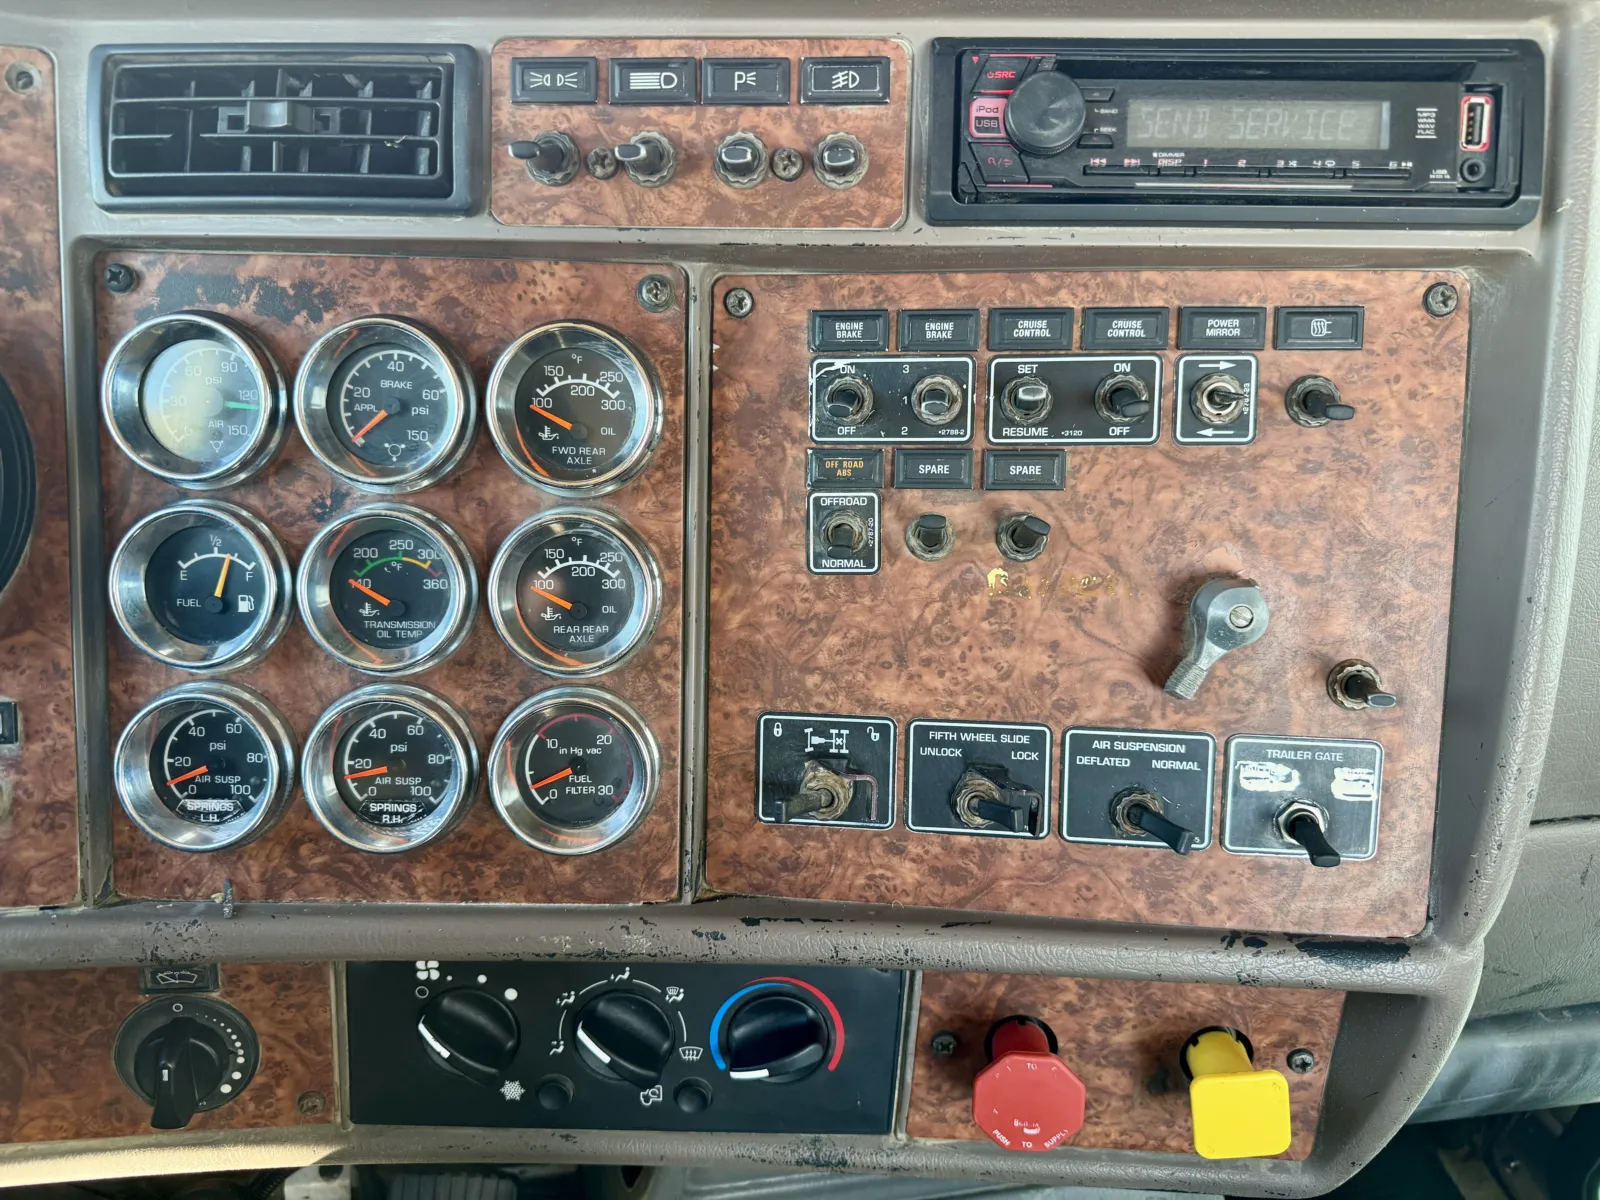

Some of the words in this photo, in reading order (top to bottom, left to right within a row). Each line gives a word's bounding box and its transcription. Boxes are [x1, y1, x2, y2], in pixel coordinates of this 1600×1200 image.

[976, 105, 999, 114] iPod
[975, 120, 998, 128] USB
[1137, 107, 1210, 138] SEND
[1229, 108, 1356, 140] SERVICE
[835, 322, 864, 330] ENGINE
[925, 322, 954, 331] ENGINE
[1018, 320, 1048, 328] CRUISE
[1112, 320, 1142, 328] CRUISE
[1207, 320, 1240, 328] POWER
[836, 330, 862, 339] BRAKE
[926, 331, 952, 339] BRAKE
[1013, 328, 1052, 337] CONTROL
[1107, 328, 1146, 338] CONTROL
[1206, 328, 1241, 337] MIRROR
[185, 366, 202, 376] 60
[221, 362, 238, 372] 90
[387, 361, 405, 372] 40
[544, 366, 564, 376] 150
[840, 364, 856, 374] ON
[902, 364, 910, 374] 3
[1018, 364, 1038, 374] SET
[1114, 362, 1131, 373] ON
[205, 374, 222, 385] psi
[600, 371, 624, 383] 250
[380, 380, 413, 390] BRAKE
[238, 390, 258, 400] 120
[353, 387, 371, 398] 20
[422, 389, 440, 401] 60
[570, 385, 595, 396] 200
[532, 398, 553, 409] 100
[601, 400, 626, 411] 300
[902, 396, 908, 405] 1
[411, 405, 429, 416] psi
[208, 420, 224, 428] AIR
[228, 425, 248, 436] 150
[600, 427, 616, 436] OIL
[837, 426, 856, 435] OFF
[901, 426, 909, 436] 2
[1002, 427, 1049, 437] RESUME
[1108, 426, 1130, 436] OFF
[406, 430, 429, 442] 150
[552, 446, 576, 455] FWD
[579, 447, 606, 456] REAR
[566, 457, 592, 465] AXLE
[825, 460, 840, 468] OFF
[842, 460, 864, 468] ROAD
[836, 469, 852, 477] ABS
[918, 464, 950, 474] SPARE
[1009, 465, 1042, 475] SPARE
[820, 497, 868, 506] OFFROAD
[389, 540, 414, 550] 250
[353, 548, 378, 558] 200
[544, 548, 564, 559] 150
[600, 552, 623, 562] 250
[822, 559, 866, 568] NORMAL
[180, 570, 188, 581] E
[571, 566, 596, 577] 200
[246, 572, 254, 582] F
[423, 579, 448, 590] 360
[533, 579, 554, 590] 100
[601, 579, 626, 590] 300
[176, 598, 202, 608] FUEL
[601, 606, 617, 614] OIL
[364, 621, 436, 629] TRANSMISSION
[376, 630, 392, 638] OIL
[395, 630, 423, 638] TEMP
[569, 635, 595, 643] AXLE
[188, 726, 206, 737] 40
[226, 723, 242, 734] 60
[369, 728, 387, 739] 40
[407, 725, 424, 736] 60
[596, 735, 612, 745] 20
[929, 731, 957, 741] FIFTH
[960, 732, 998, 743] WHEEL
[1000, 734, 1030, 744] SLIDE
[209, 740, 227, 752] psi
[390, 742, 408, 754] psi
[546, 738, 558, 749] 10
[1092, 740, 1111, 750] AIR
[1113, 741, 1186, 754] SUSPENSION
[570, 747, 583, 757] Hg
[920, 747, 962, 758] UNLOCK
[1011, 750, 1039, 761] LOCK
[1266, 749, 1312, 761] TRAILER
[1315, 751, 1344, 762] GATE
[174, 756, 192, 767] 20
[246, 752, 264, 763] 80
[427, 754, 445, 765] 80
[1076, 756, 1131, 768] DEFLATED
[354, 758, 372, 769] 20
[1152, 759, 1200, 771] NORMAL
[214, 775, 241, 784] SUSP
[375, 777, 391, 785] AIR
[395, 777, 422, 785] SUSP
[569, 775, 592, 783] FUEL
[188, 784, 197, 795] 0
[230, 784, 251, 795] 100
[368, 786, 377, 797] 0
[411, 786, 432, 797] 100
[549, 789, 558, 799] 0
[566, 786, 596, 795] FILTER
[598, 785, 614, 796] 30
[186, 801, 234, 812] SPRINGS
[369, 803, 417, 813] SPRINGS
[992, 1129, 1011, 1146] PUSH
[1043, 1129, 1069, 1148] SUPPLY
